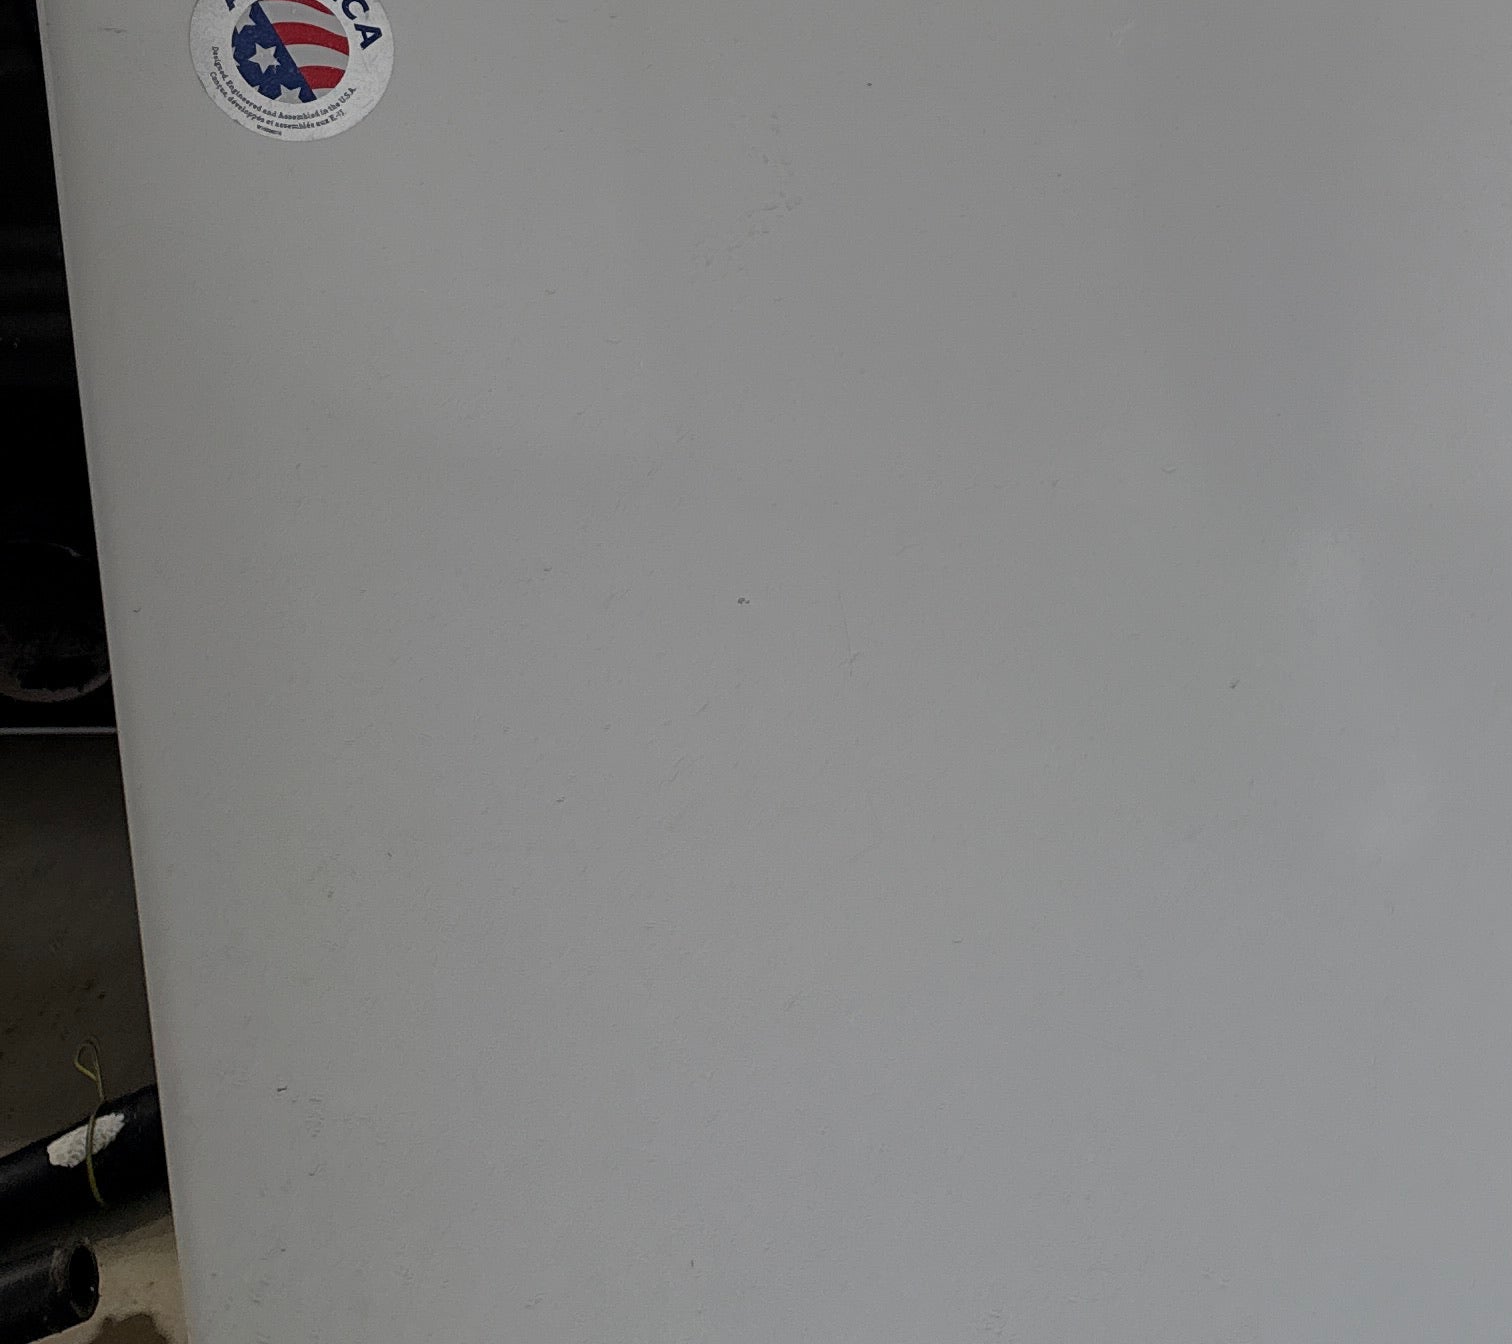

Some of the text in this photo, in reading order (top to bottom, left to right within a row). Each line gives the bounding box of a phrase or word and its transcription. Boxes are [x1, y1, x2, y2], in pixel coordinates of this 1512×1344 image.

[226, 79, 263, 112] Engineered
[263, 108, 277, 118] and
[278, 109, 320, 120] Assembled
[320, 108, 329, 116] in
[328, 102, 341, 112] the
